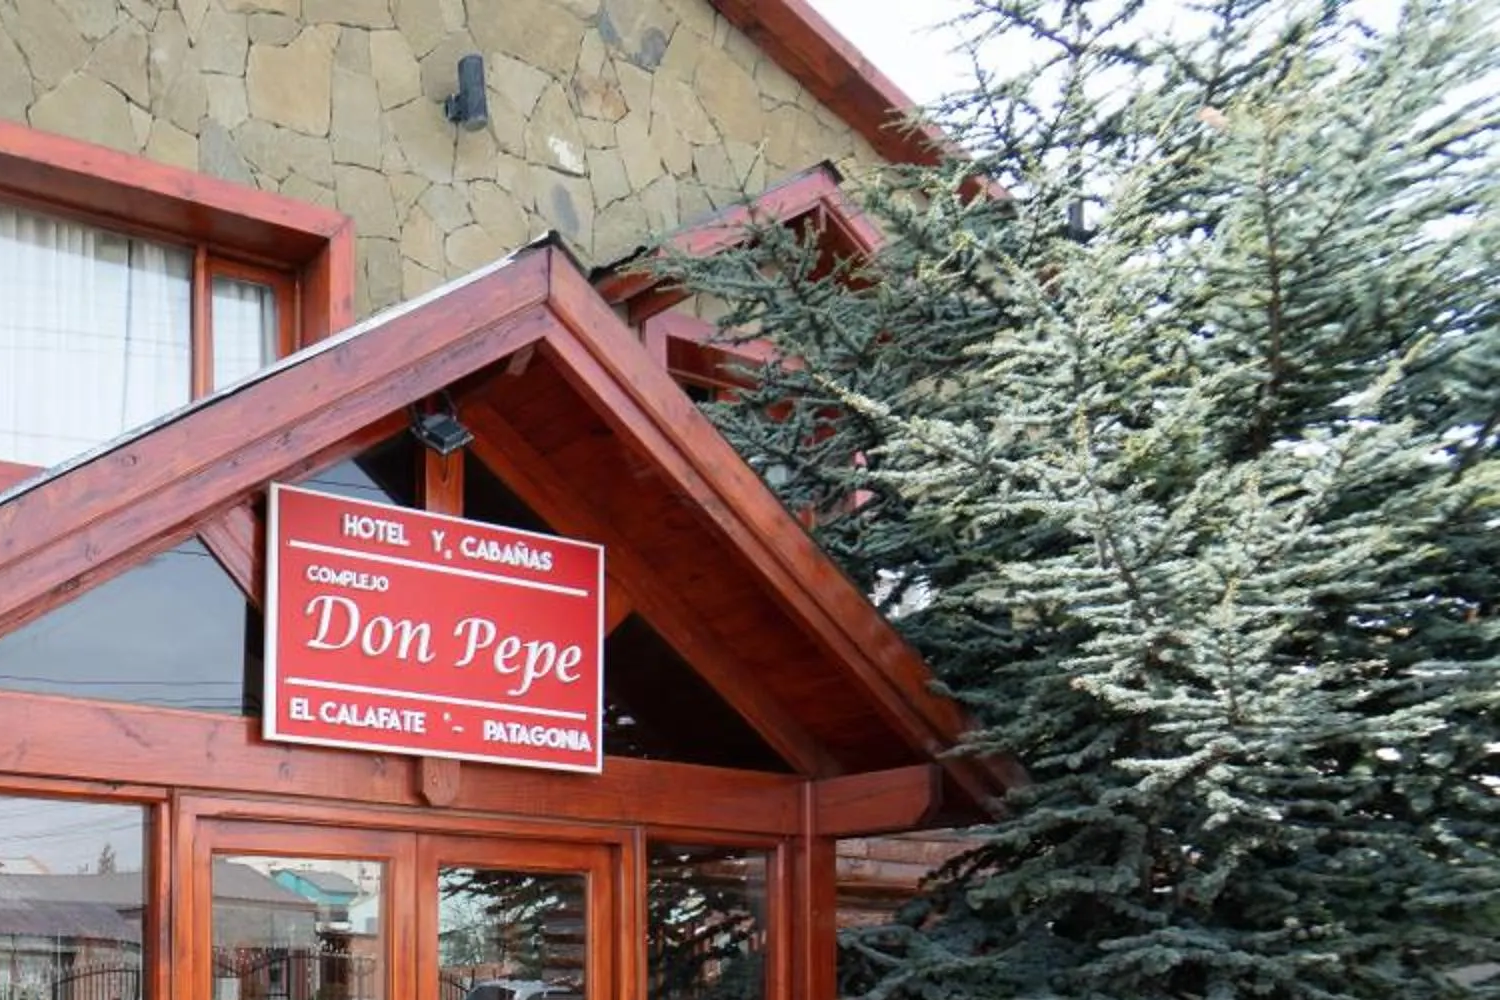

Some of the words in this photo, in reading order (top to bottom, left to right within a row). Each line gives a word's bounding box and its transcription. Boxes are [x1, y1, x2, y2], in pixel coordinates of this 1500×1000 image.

[343, 513, 409, 546] HOTEL
[460, 536, 553, 571] CABAÑAS
[306, 564, 389, 591] COMPLEJO
[305, 595, 436, 664] Don
[453, 617, 582, 696] Pepe
[289, 697, 314, 721] EL
[320, 702, 426, 733] CALAFATE
[483, 719, 591, 751] PATAGONIA
